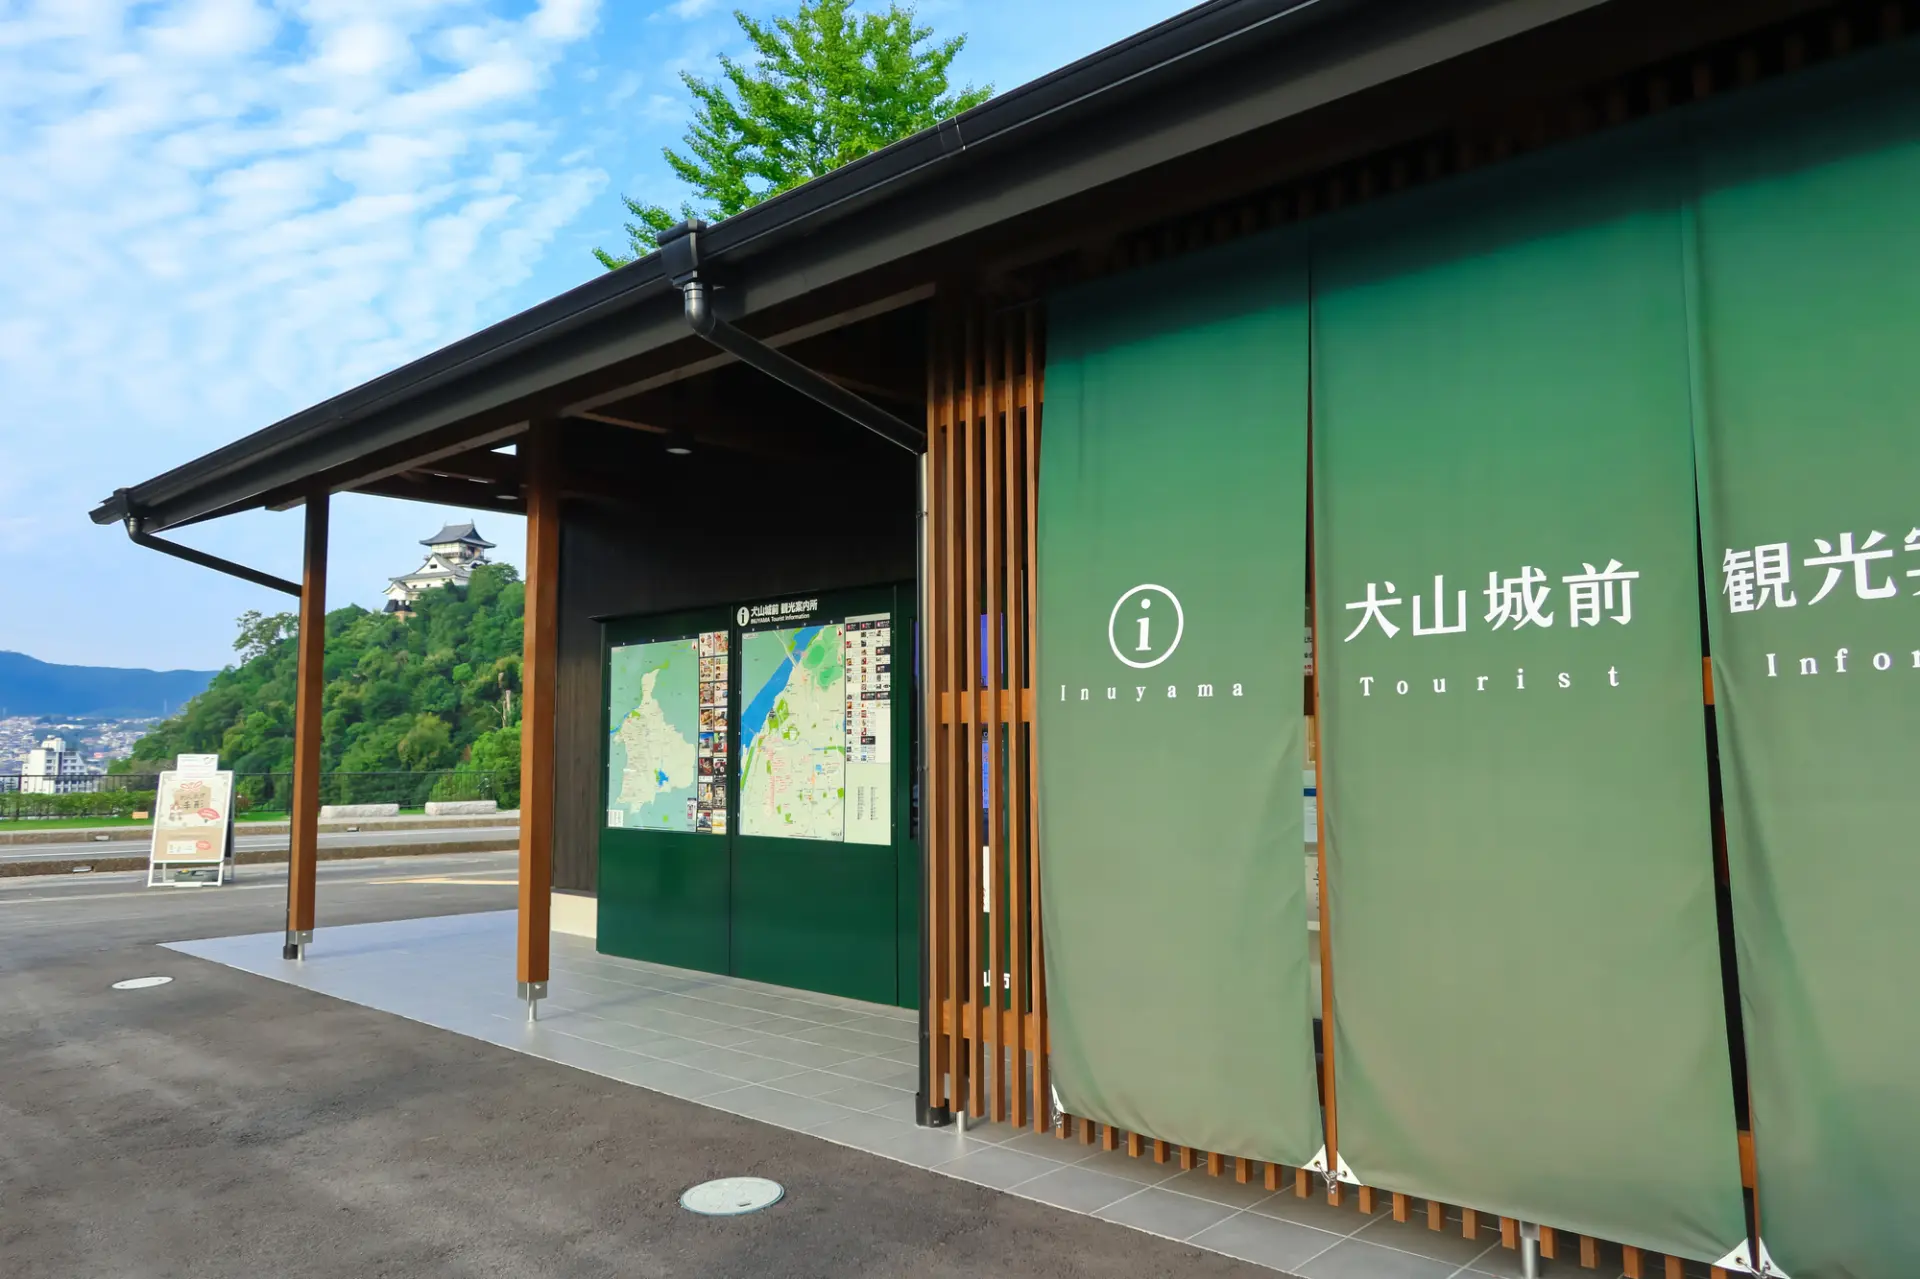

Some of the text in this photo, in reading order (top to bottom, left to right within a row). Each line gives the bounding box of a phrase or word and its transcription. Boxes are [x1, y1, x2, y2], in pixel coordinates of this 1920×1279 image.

[1344, 526, 1920, 643] 犬山城前 観光
[750, 599, 818, 617] 犬山城前 観光案内所
[1060, 682, 1243, 703] Inuyama
[1359, 666, 1620, 697] Tourist
